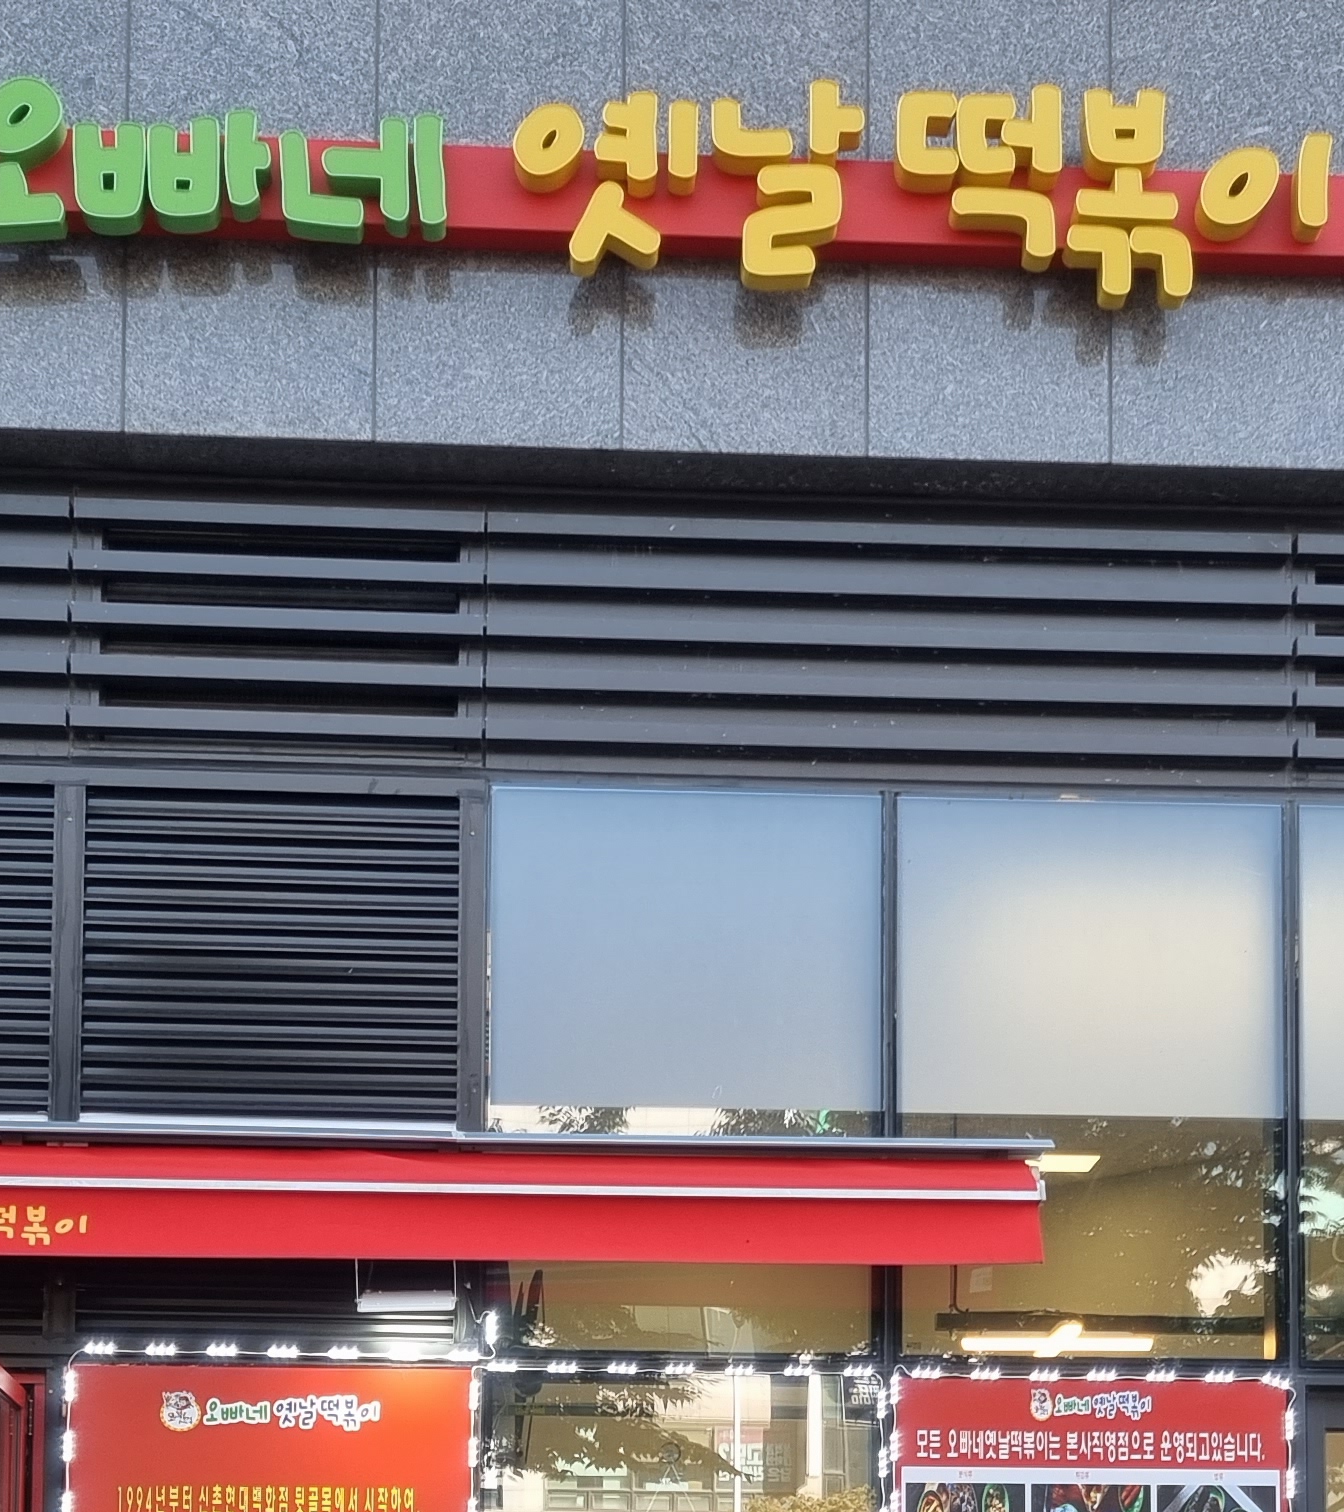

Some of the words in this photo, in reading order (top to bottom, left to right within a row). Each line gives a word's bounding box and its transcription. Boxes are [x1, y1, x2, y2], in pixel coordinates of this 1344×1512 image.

[204, 1399, 270, 1424] 오빠네
[917, 1430, 941, 1458] 모든
[947, 1429, 1060, 1460] 오빠네옛날떡볶이는
[1066, 1430, 1154, 1462] 본사직영점으로
